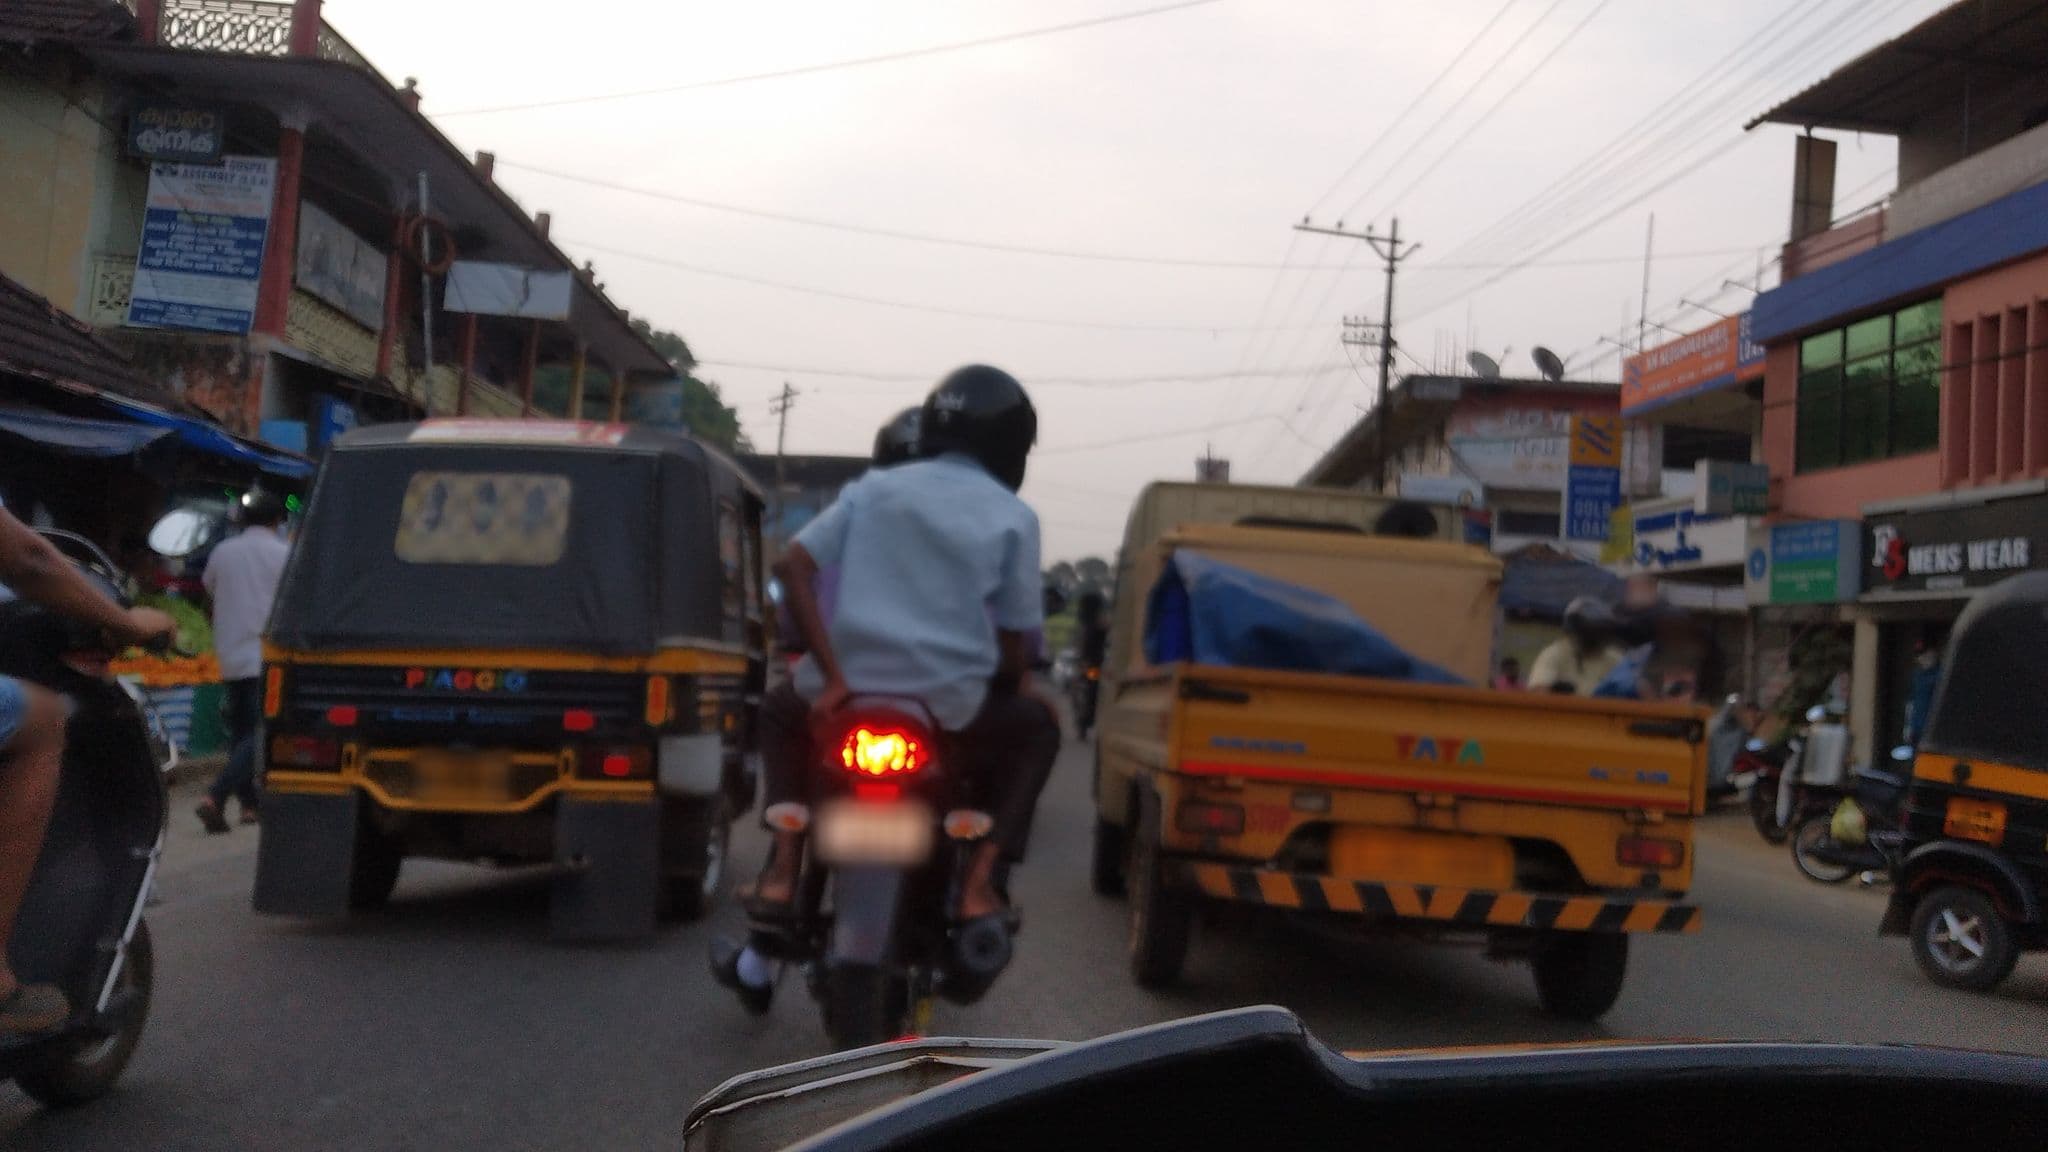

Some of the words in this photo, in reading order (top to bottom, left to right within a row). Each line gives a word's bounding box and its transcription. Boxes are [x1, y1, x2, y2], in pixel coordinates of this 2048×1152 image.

[182, 166, 236, 184] ASSEMBLY
[1907, 543, 1963, 575] MENS
[1967, 536, 2029, 571] WEAR
[405, 666, 528, 691] PIAGGIO
[1396, 734, 1485, 765] TATA
